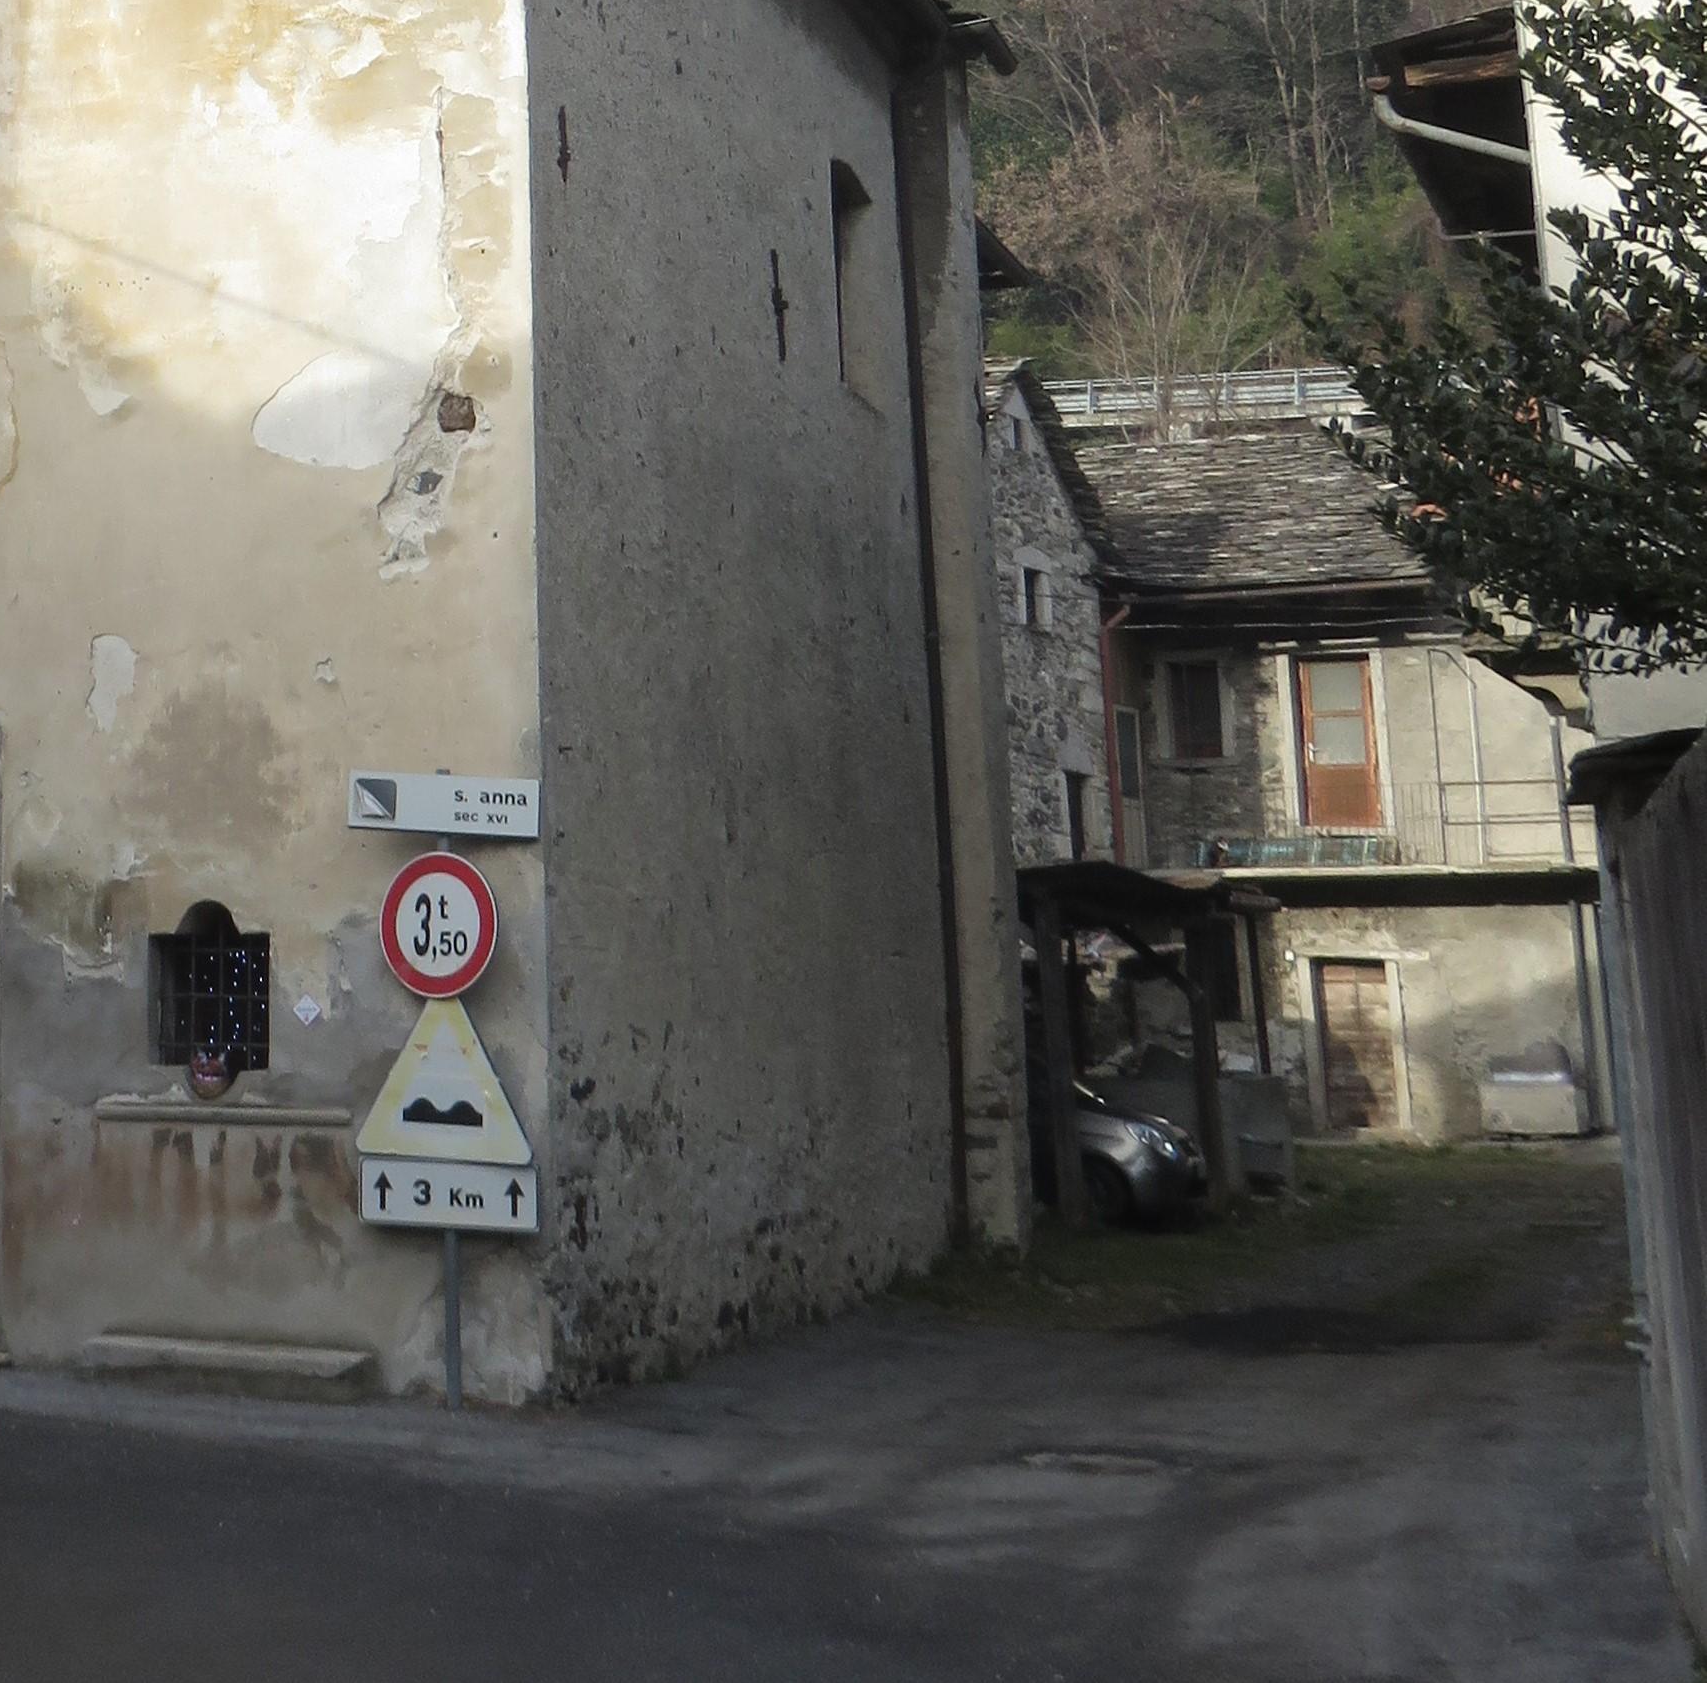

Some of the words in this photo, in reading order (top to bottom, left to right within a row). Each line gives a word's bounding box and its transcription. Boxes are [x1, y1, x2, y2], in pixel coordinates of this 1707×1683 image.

[454, 789, 468, 803] s.
[479, 790, 528, 806] anna
[454, 811, 479, 822] sec
[412, 1178, 432, 1206] 3
[449, 1186, 485, 1209] Km
